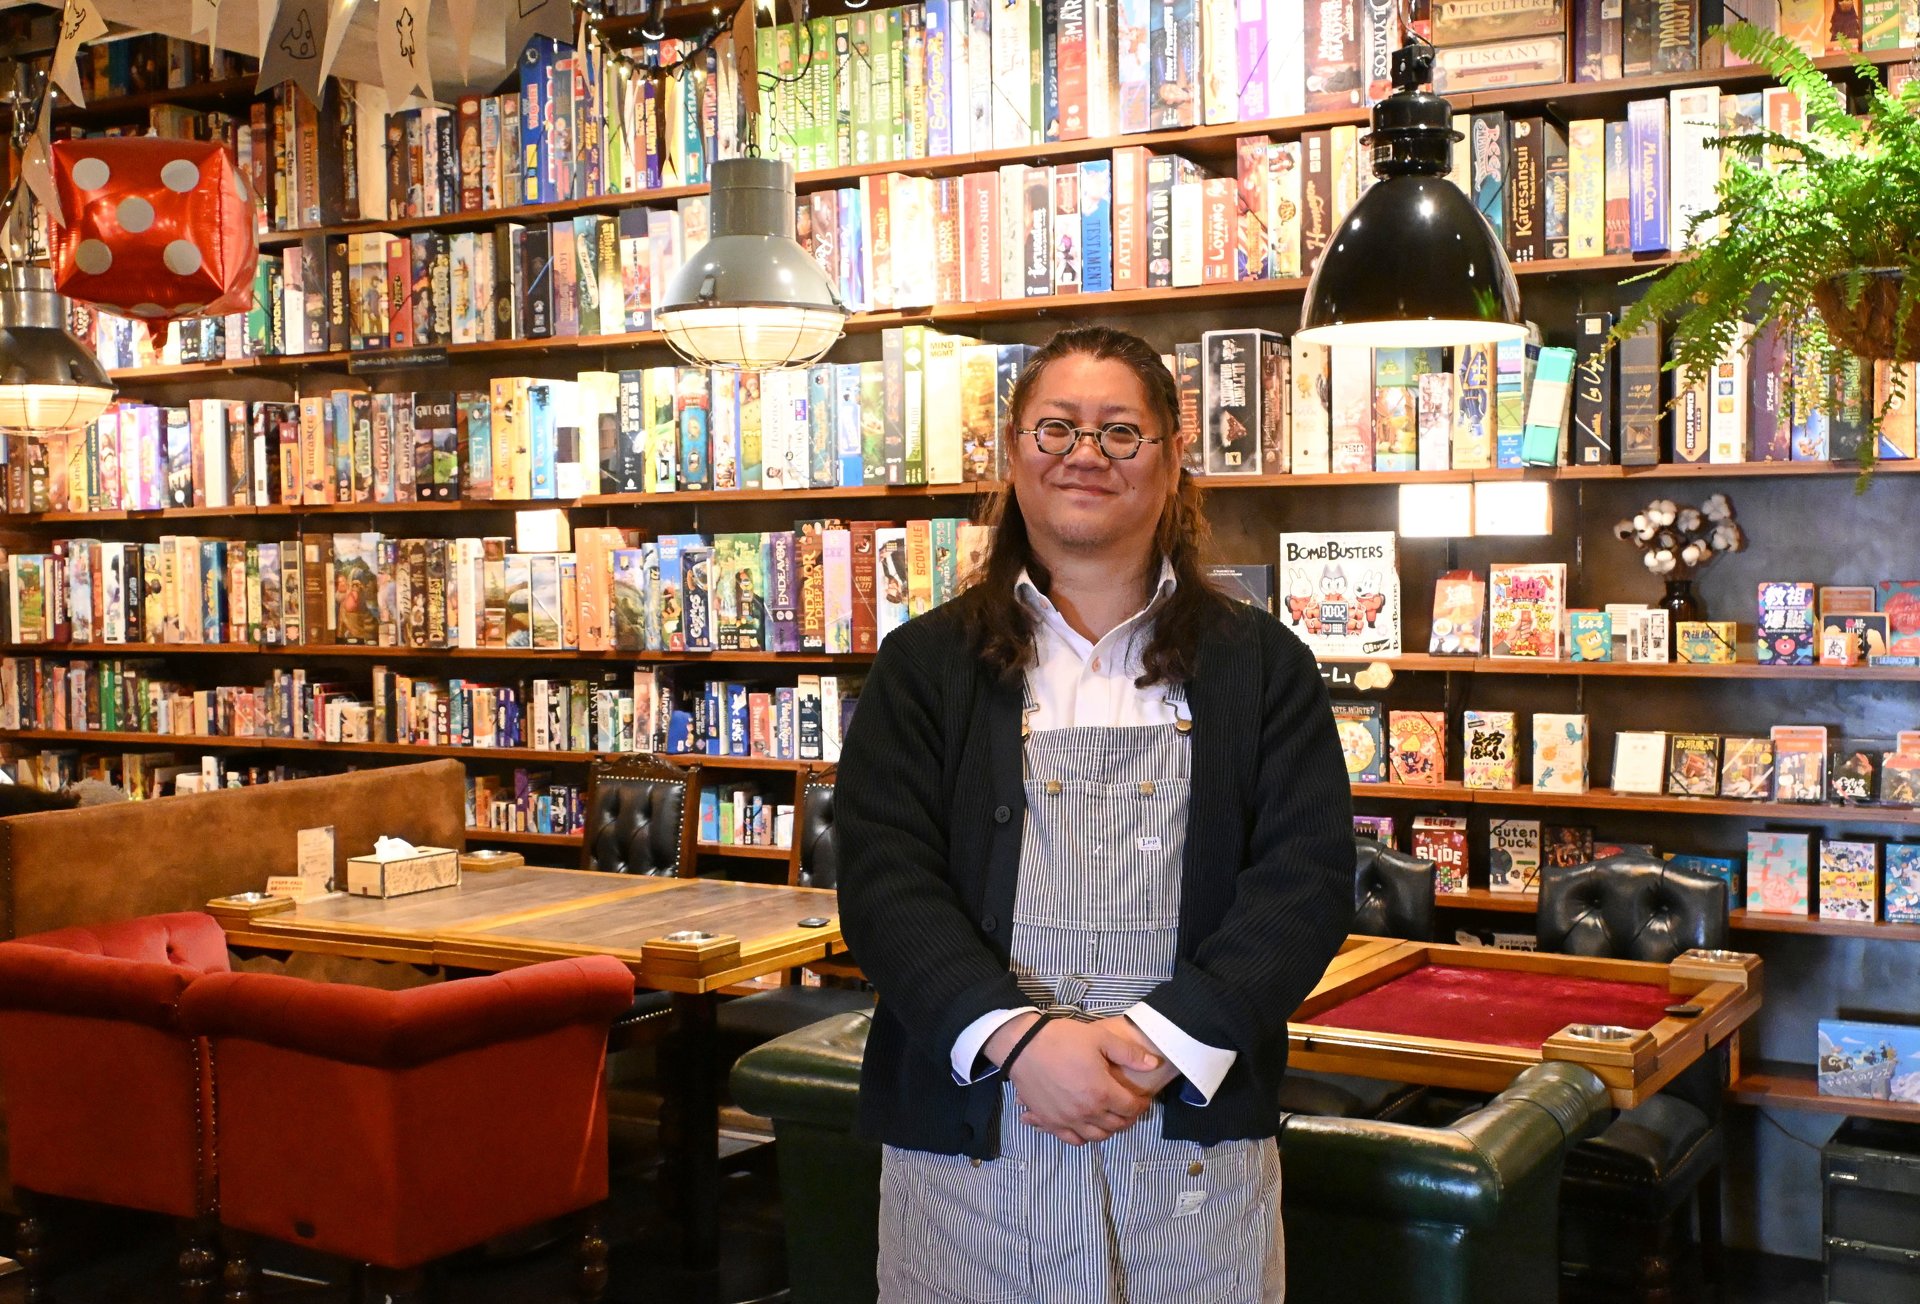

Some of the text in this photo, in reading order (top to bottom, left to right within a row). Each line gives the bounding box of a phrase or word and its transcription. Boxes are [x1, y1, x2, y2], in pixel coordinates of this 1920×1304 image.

[1456, 44, 1543, 66] TUSCANY
[911, 84, 922, 156] FACTORY FUN
[1152, 189, 1169, 240] PATIN
[1305, 180, 1327, 250] Hermagor
[1514, 146, 1533, 237] Karesansui
[978, 188, 991, 285] JOHN COMPANY
[1086, 219, 1102, 288] TESTAMENT
[1118, 206, 1131, 267] ATTIKA
[1209, 203, 1225, 260] LOYANG
[331, 270, 344, 325] SAPIENS
[929, 341, 954, 350] MIND
[929, 350, 955, 360] MGMT
[1181, 388, 1201, 445] Lumis
[1686, 392, 1695, 449] STEAM POWER
[305, 414, 316, 477] Lancaster
[776, 539, 789, 606] ENDEAVOR
[913, 525, 927, 576] SCOVILLE
[802, 549, 817, 631] ENDEAVOR
[813, 564, 824, 618] DEEP SEA
[1321, 605, 1346, 618] 00:02
[1764, 586, 1806, 606] 教祖
[1764, 611, 1806, 630] 爆誕
[1423, 817, 1458, 829] SLIDE
[1493, 825, 1538, 838] Guten
[1497, 836, 1533, 849] Duck
[1415, 845, 1463, 866] SLIDE
